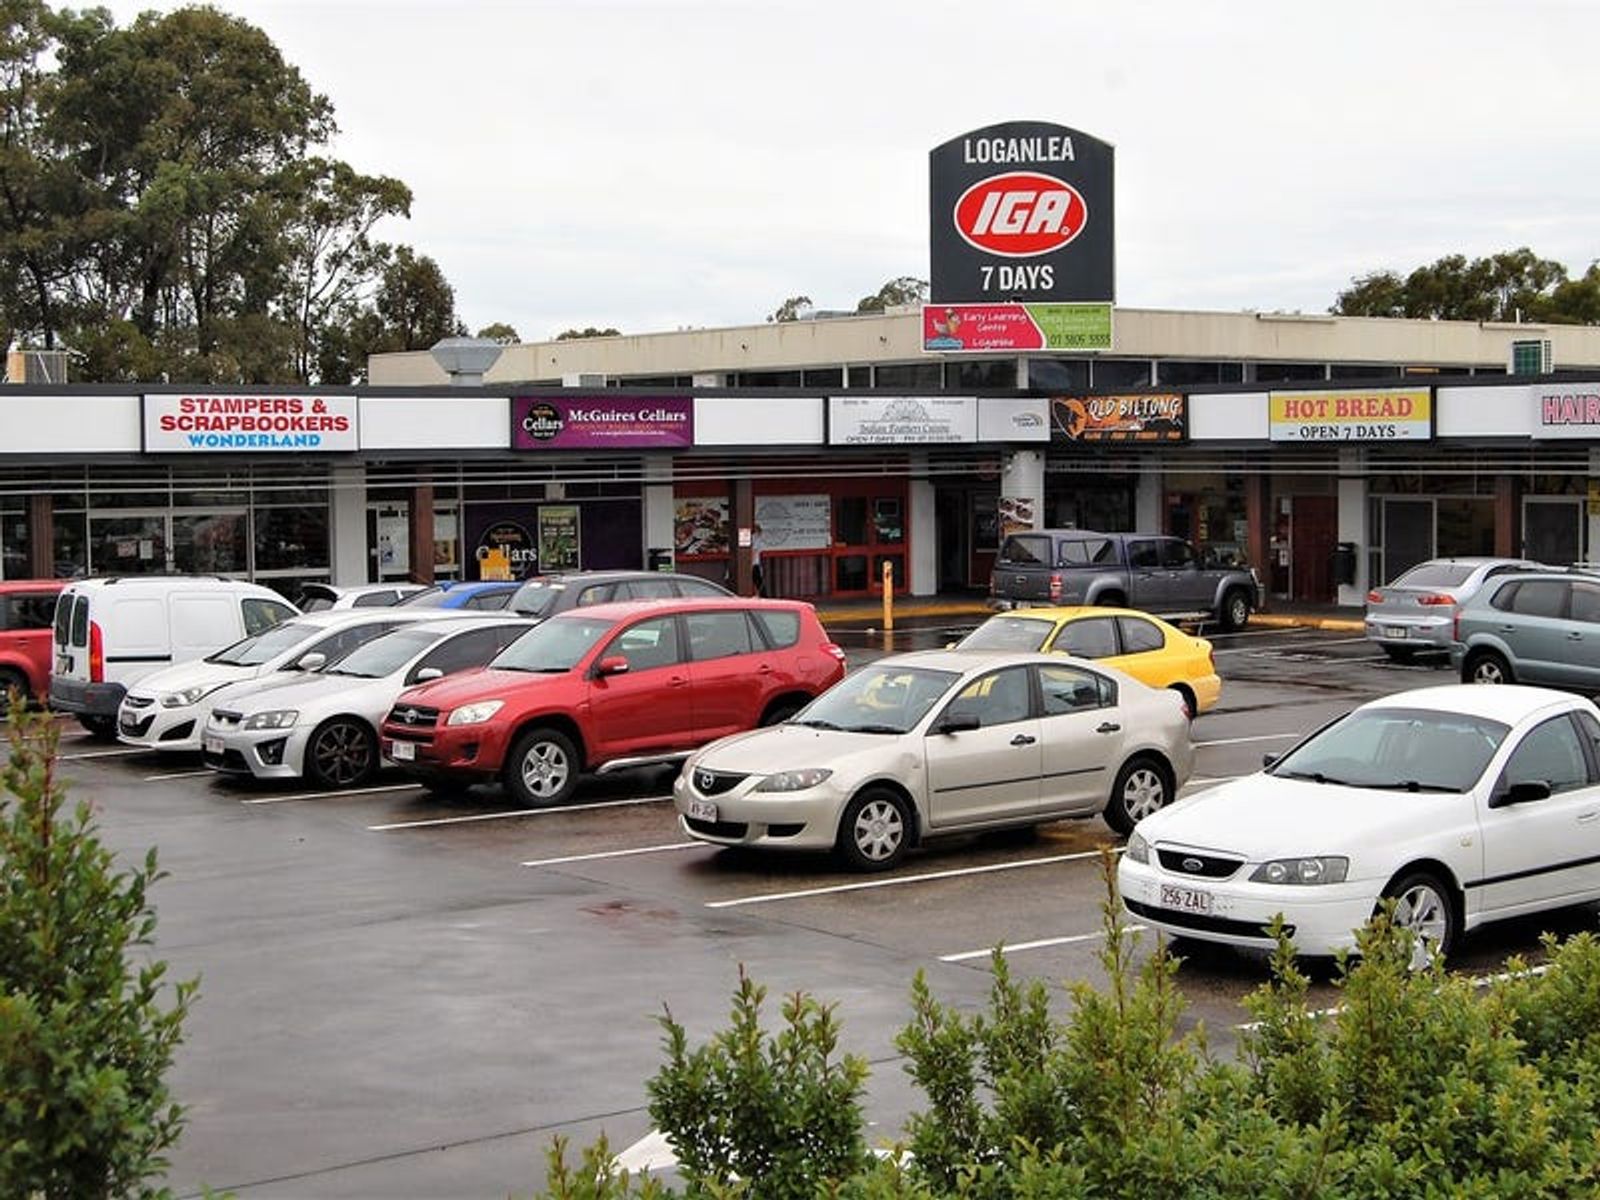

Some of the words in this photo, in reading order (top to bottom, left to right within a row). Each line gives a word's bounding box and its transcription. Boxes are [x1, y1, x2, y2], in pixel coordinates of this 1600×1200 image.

[964, 137, 1075, 163] LOGANLEA
[971, 190, 1071, 235] IGA
[981, 266, 993, 291] 7
[1000, 265, 1054, 290] DAYS
[180, 398, 303, 413] STAMPERS
[312, 398, 327, 413] &
[1089, 398, 1116, 420] QLD
[1119, 397, 1181, 419] BILTONG
[1284, 400, 1329, 418] HOT
[1335, 397, 1413, 417] BREAD
[1542, 395, 1600, 424] HAIR
[160, 415, 349, 431] SCRAPBOOKERS
[522, 416, 564, 431] Cellars
[568, 409, 635, 422] McGuires
[638, 409, 687, 422] Cellars
[188, 434, 321, 447] WONDERLAND
[1300, 426, 1339, 438] OPEN
[1344, 427, 1351, 439] 7
[1356, 424, 1396, 437] DAYS
[476, 544, 537, 561] Cllars
[1184, 891, 1207, 910] ZAL
